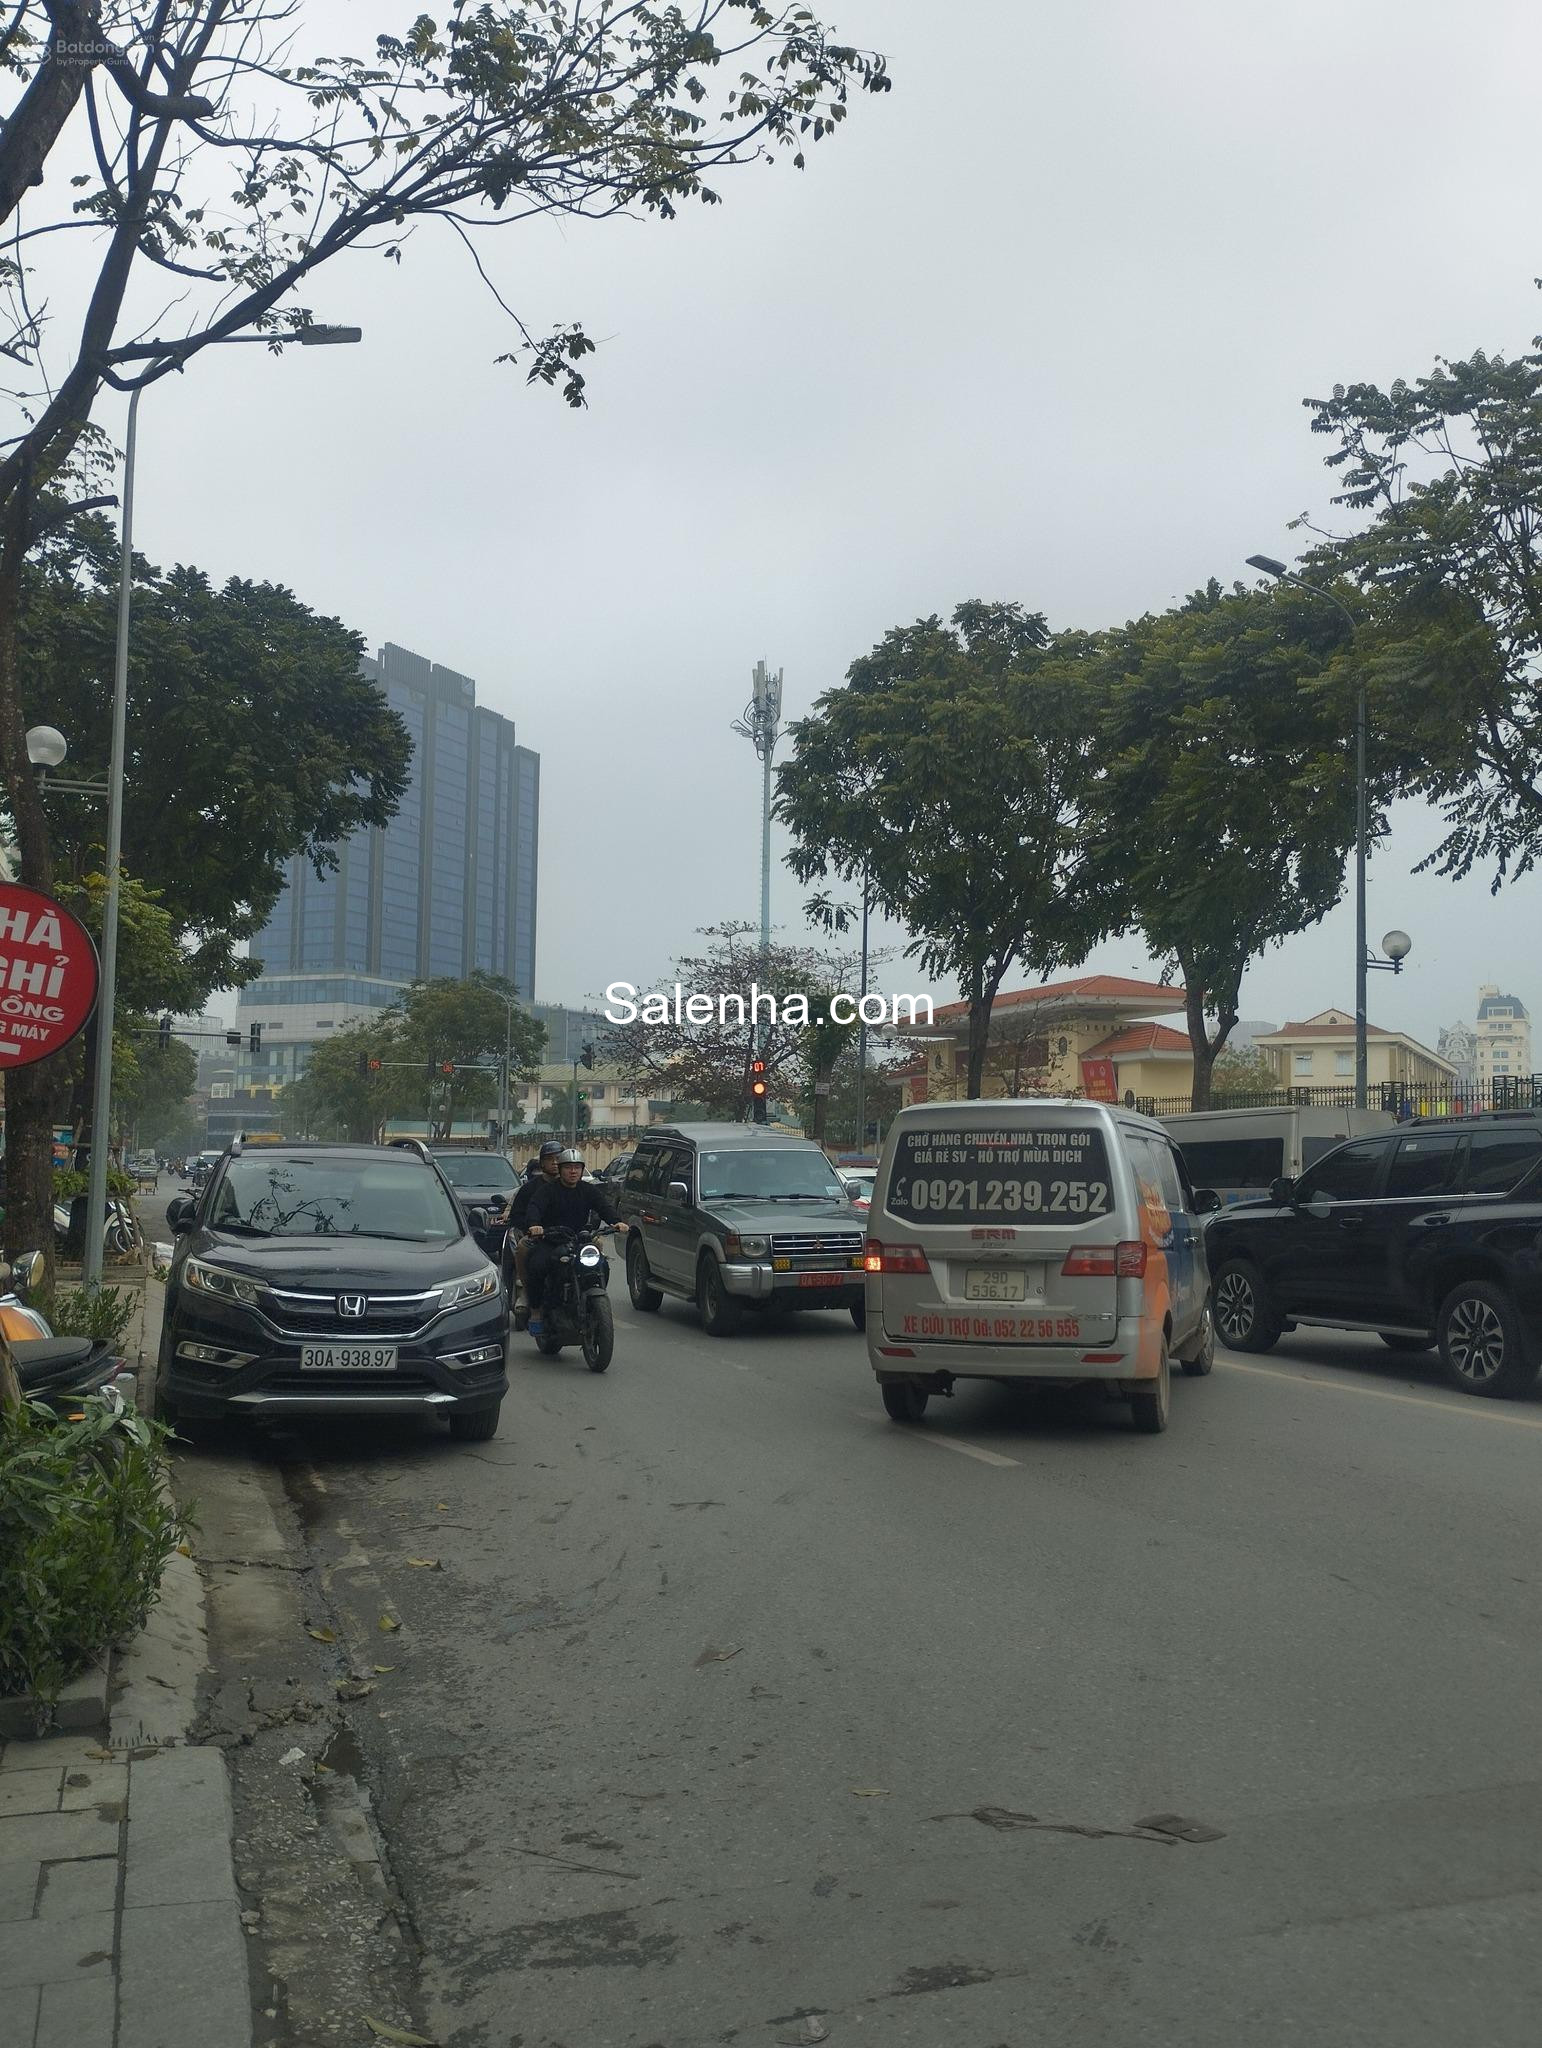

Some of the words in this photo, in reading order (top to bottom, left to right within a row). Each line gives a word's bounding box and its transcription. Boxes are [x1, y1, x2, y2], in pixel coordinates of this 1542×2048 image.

[11, 1023, 50, 1041] MÁY
[952, 1151, 967, 1163] SV
[1023, 1146, 1050, 1163] MÙA
[1053, 1150, 1083, 1165] DỊCH
[911, 1179, 1108, 1214] 0921.239.252
[982, 1271, 1009, 1284] 29D
[972, 1285, 1018, 1298] 536.17
[904, 1315, 919, 1333] XE
[994, 1319, 1016, 1338] 052
[1020, 1320, 1035, 1338] 22
[1038, 1320, 1053, 1338] 56
[1056, 1320, 1080, 1338] 555
[304, 1349, 394, 1367] 30A-938.97
